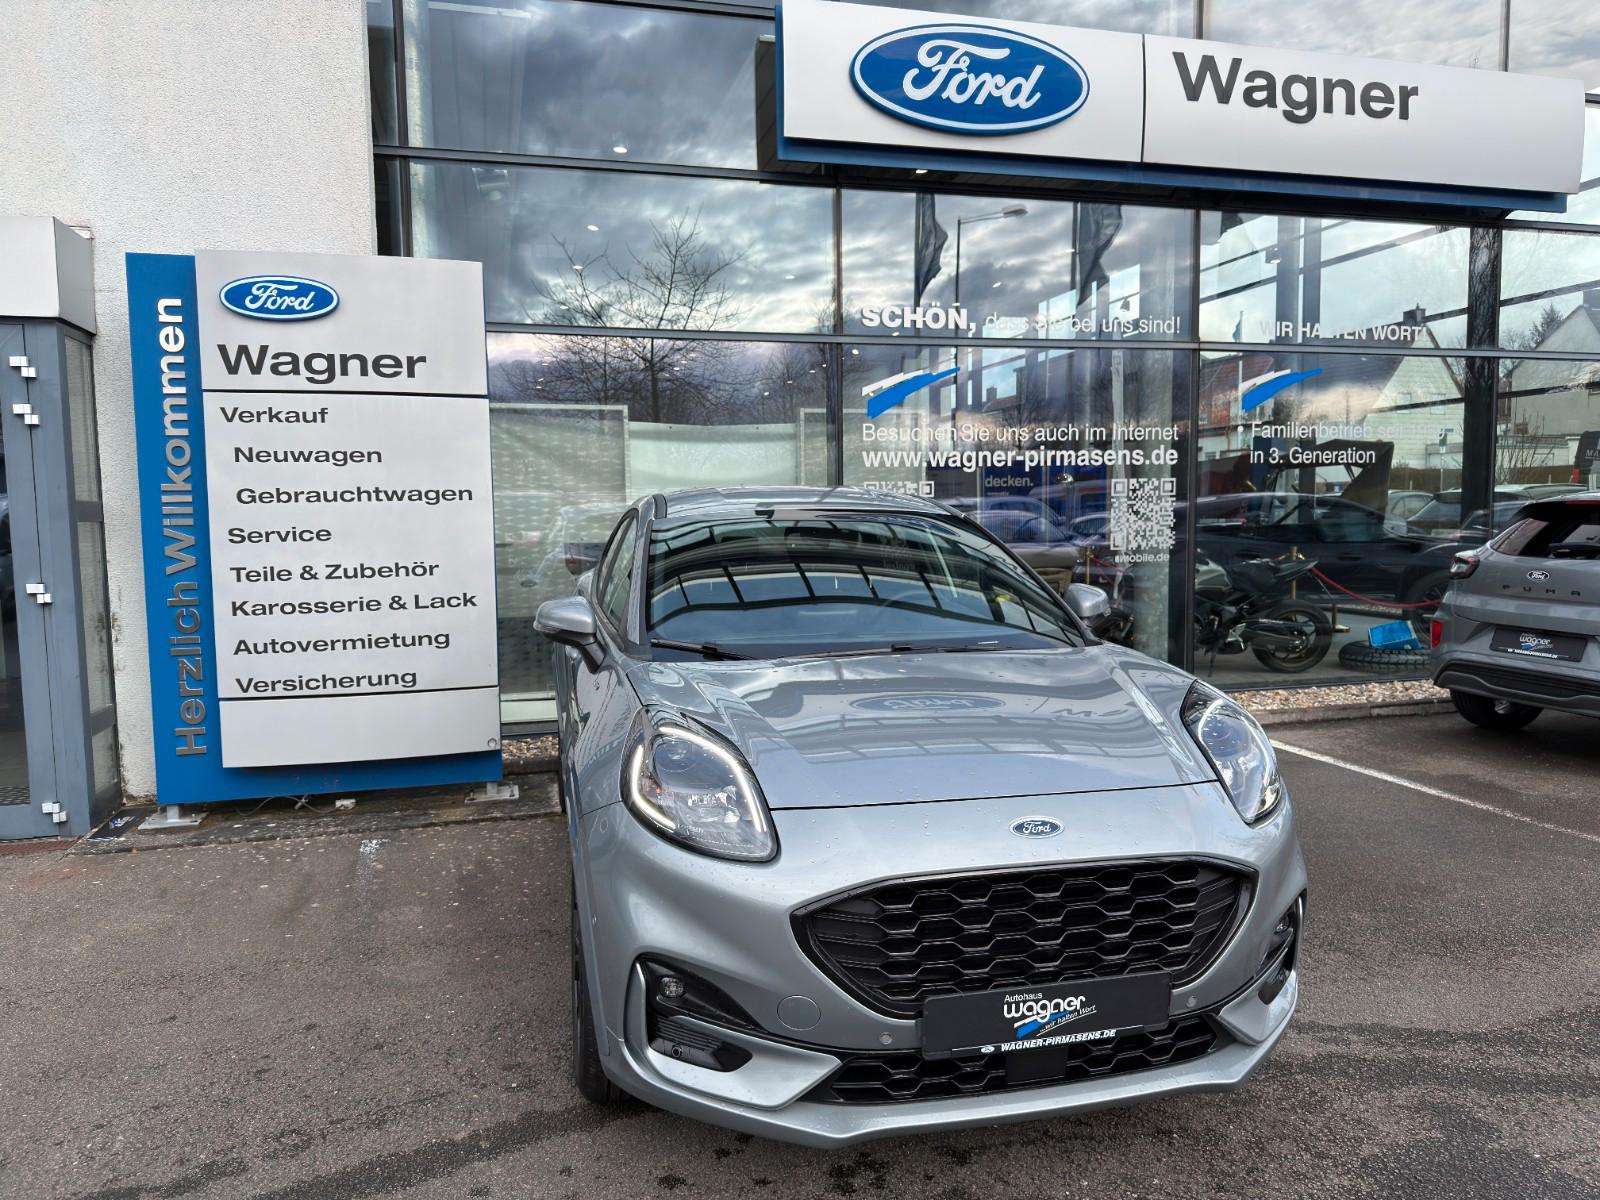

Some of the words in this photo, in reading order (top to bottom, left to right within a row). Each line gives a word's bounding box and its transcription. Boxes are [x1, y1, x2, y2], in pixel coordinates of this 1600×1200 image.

[903, 39, 1045, 109] Ford
[1172, 51, 1419, 125] Wagner
[244, 282, 316, 311] Ford
[861, 301, 976, 334] SCHÖN,
[1102, 317, 1134, 333] uns
[1138, 315, 1181, 334] sind!
[1299, 322, 1367, 341] HAEN
[217, 344, 427, 384] Wagner
[220, 406, 328, 424] Verkauf
[157, 298, 197, 576] Willkommen
[862, 423, 956, 442] Besuchen
[960, 423, 990, 442] Sie
[997, 427, 1029, 442] uns
[1034, 423, 1079, 441] auch
[1085, 424, 1106, 441] im
[1113, 423, 1180, 441] Internet
[1250, 421, 1373, 439] Familienbetrieb
[234, 446, 382, 466] Neuwagen
[861, 445, 1179, 473] www.wagner-pirmasens.de
[1269, 447, 1284, 464] 3.
[1289, 447, 1376, 464] Generation
[985, 474, 1034, 488] decken.
[236, 486, 474, 506] Gebrauchtwagen
[228, 526, 332, 544] Service
[230, 565, 293, 583] Teile
[299, 564, 319, 581] &
[325, 560, 440, 580] Zubehör
[231, 597, 382, 617] Karosserie
[388, 595, 408, 612] &
[414, 592, 478, 611] Lack
[233, 630, 451, 656] Autovermietung
[167, 581, 207, 756] Herzlich
[235, 670, 417, 694] Versicherung
[1003, 995, 1086, 1023] wagner
[1004, 992, 1043, 1003] Autohaus
[1058, 1011, 1078, 1024] halten
[1079, 1004, 1096, 1016] Wort
[1000, 1029, 1117, 1052] WAGNER-PIRMASENS.DE
